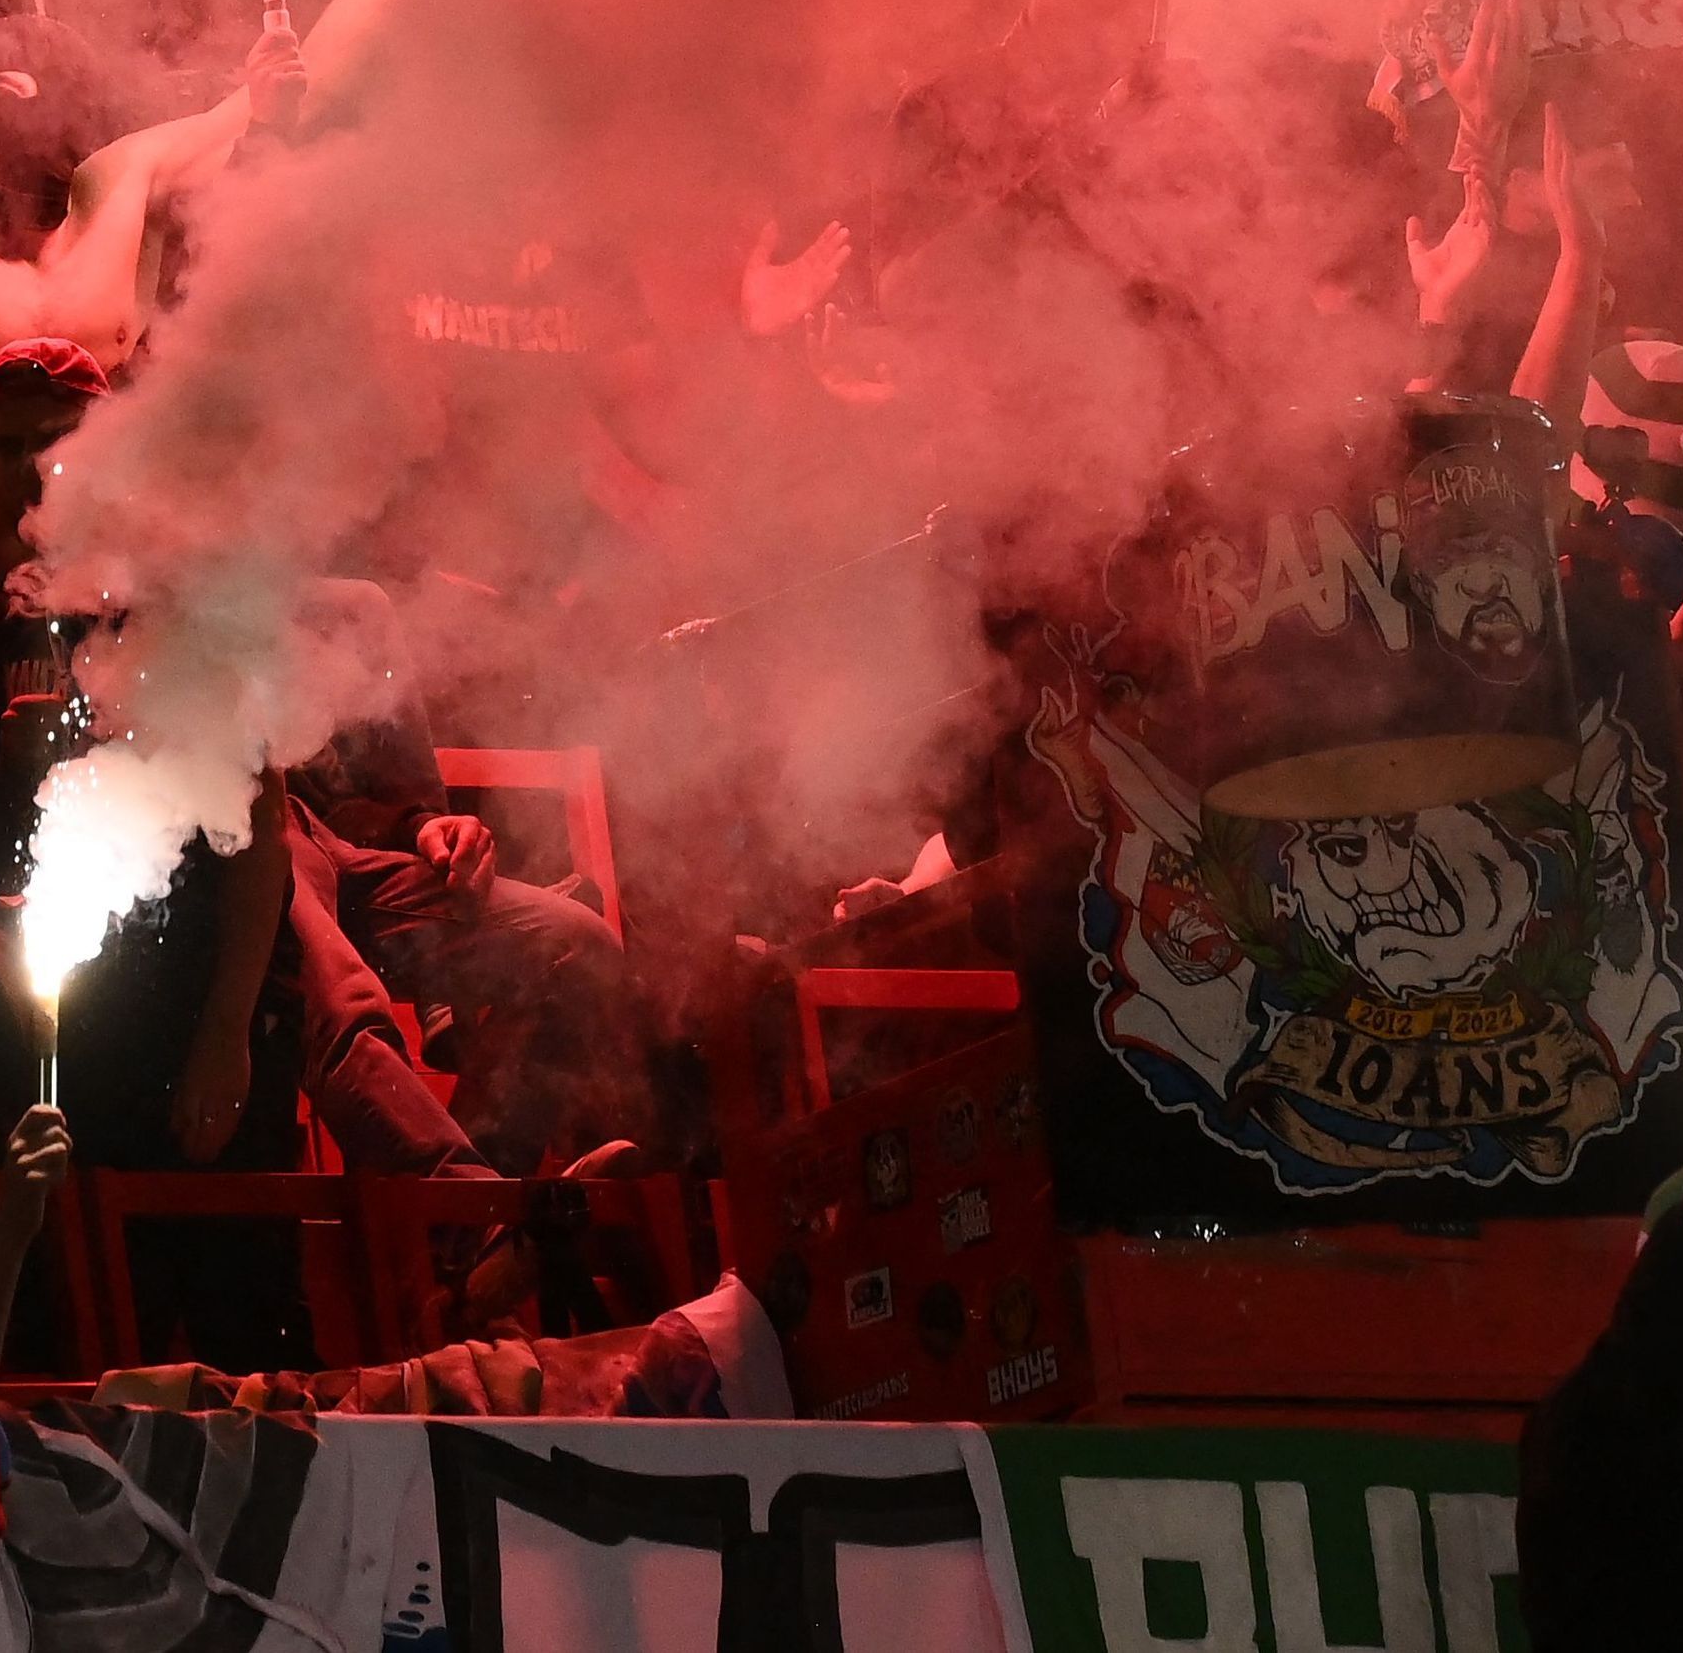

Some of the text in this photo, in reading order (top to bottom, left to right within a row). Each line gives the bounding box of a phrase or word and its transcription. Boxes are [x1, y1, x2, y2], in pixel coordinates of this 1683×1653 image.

[1355, 1005, 1513, 1036] 2012 2022
[1392, 1040, 1552, 1119] ANS
[986, 1343, 1060, 1407] BHOYS
